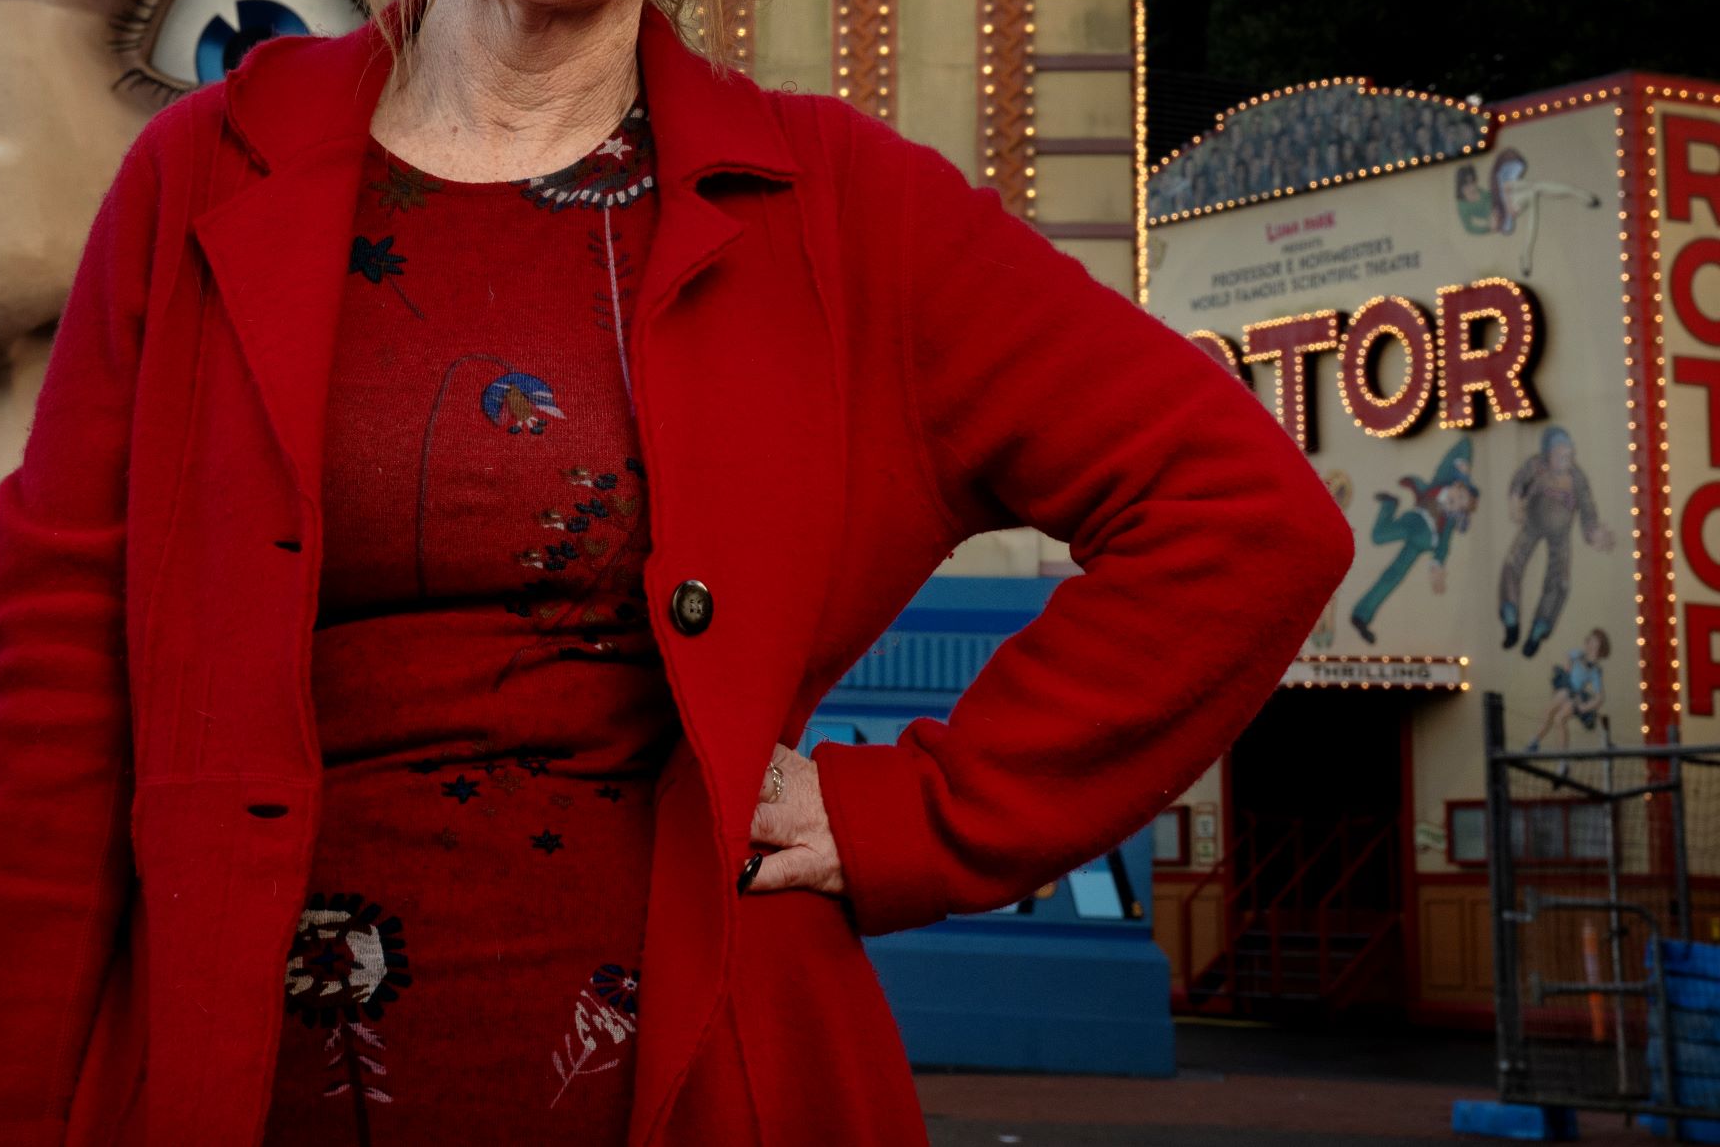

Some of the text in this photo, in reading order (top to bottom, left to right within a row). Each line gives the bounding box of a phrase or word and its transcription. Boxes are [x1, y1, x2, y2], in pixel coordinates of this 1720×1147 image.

[1190, 251, 1421, 311] WORLD FAMOUS SCIENTIFIC THEATRE
[1211, 261, 1282, 287] PROFESSOR
[1184, 277, 1538, 453] TOR
[1311, 665, 1432, 679] THRILLING
